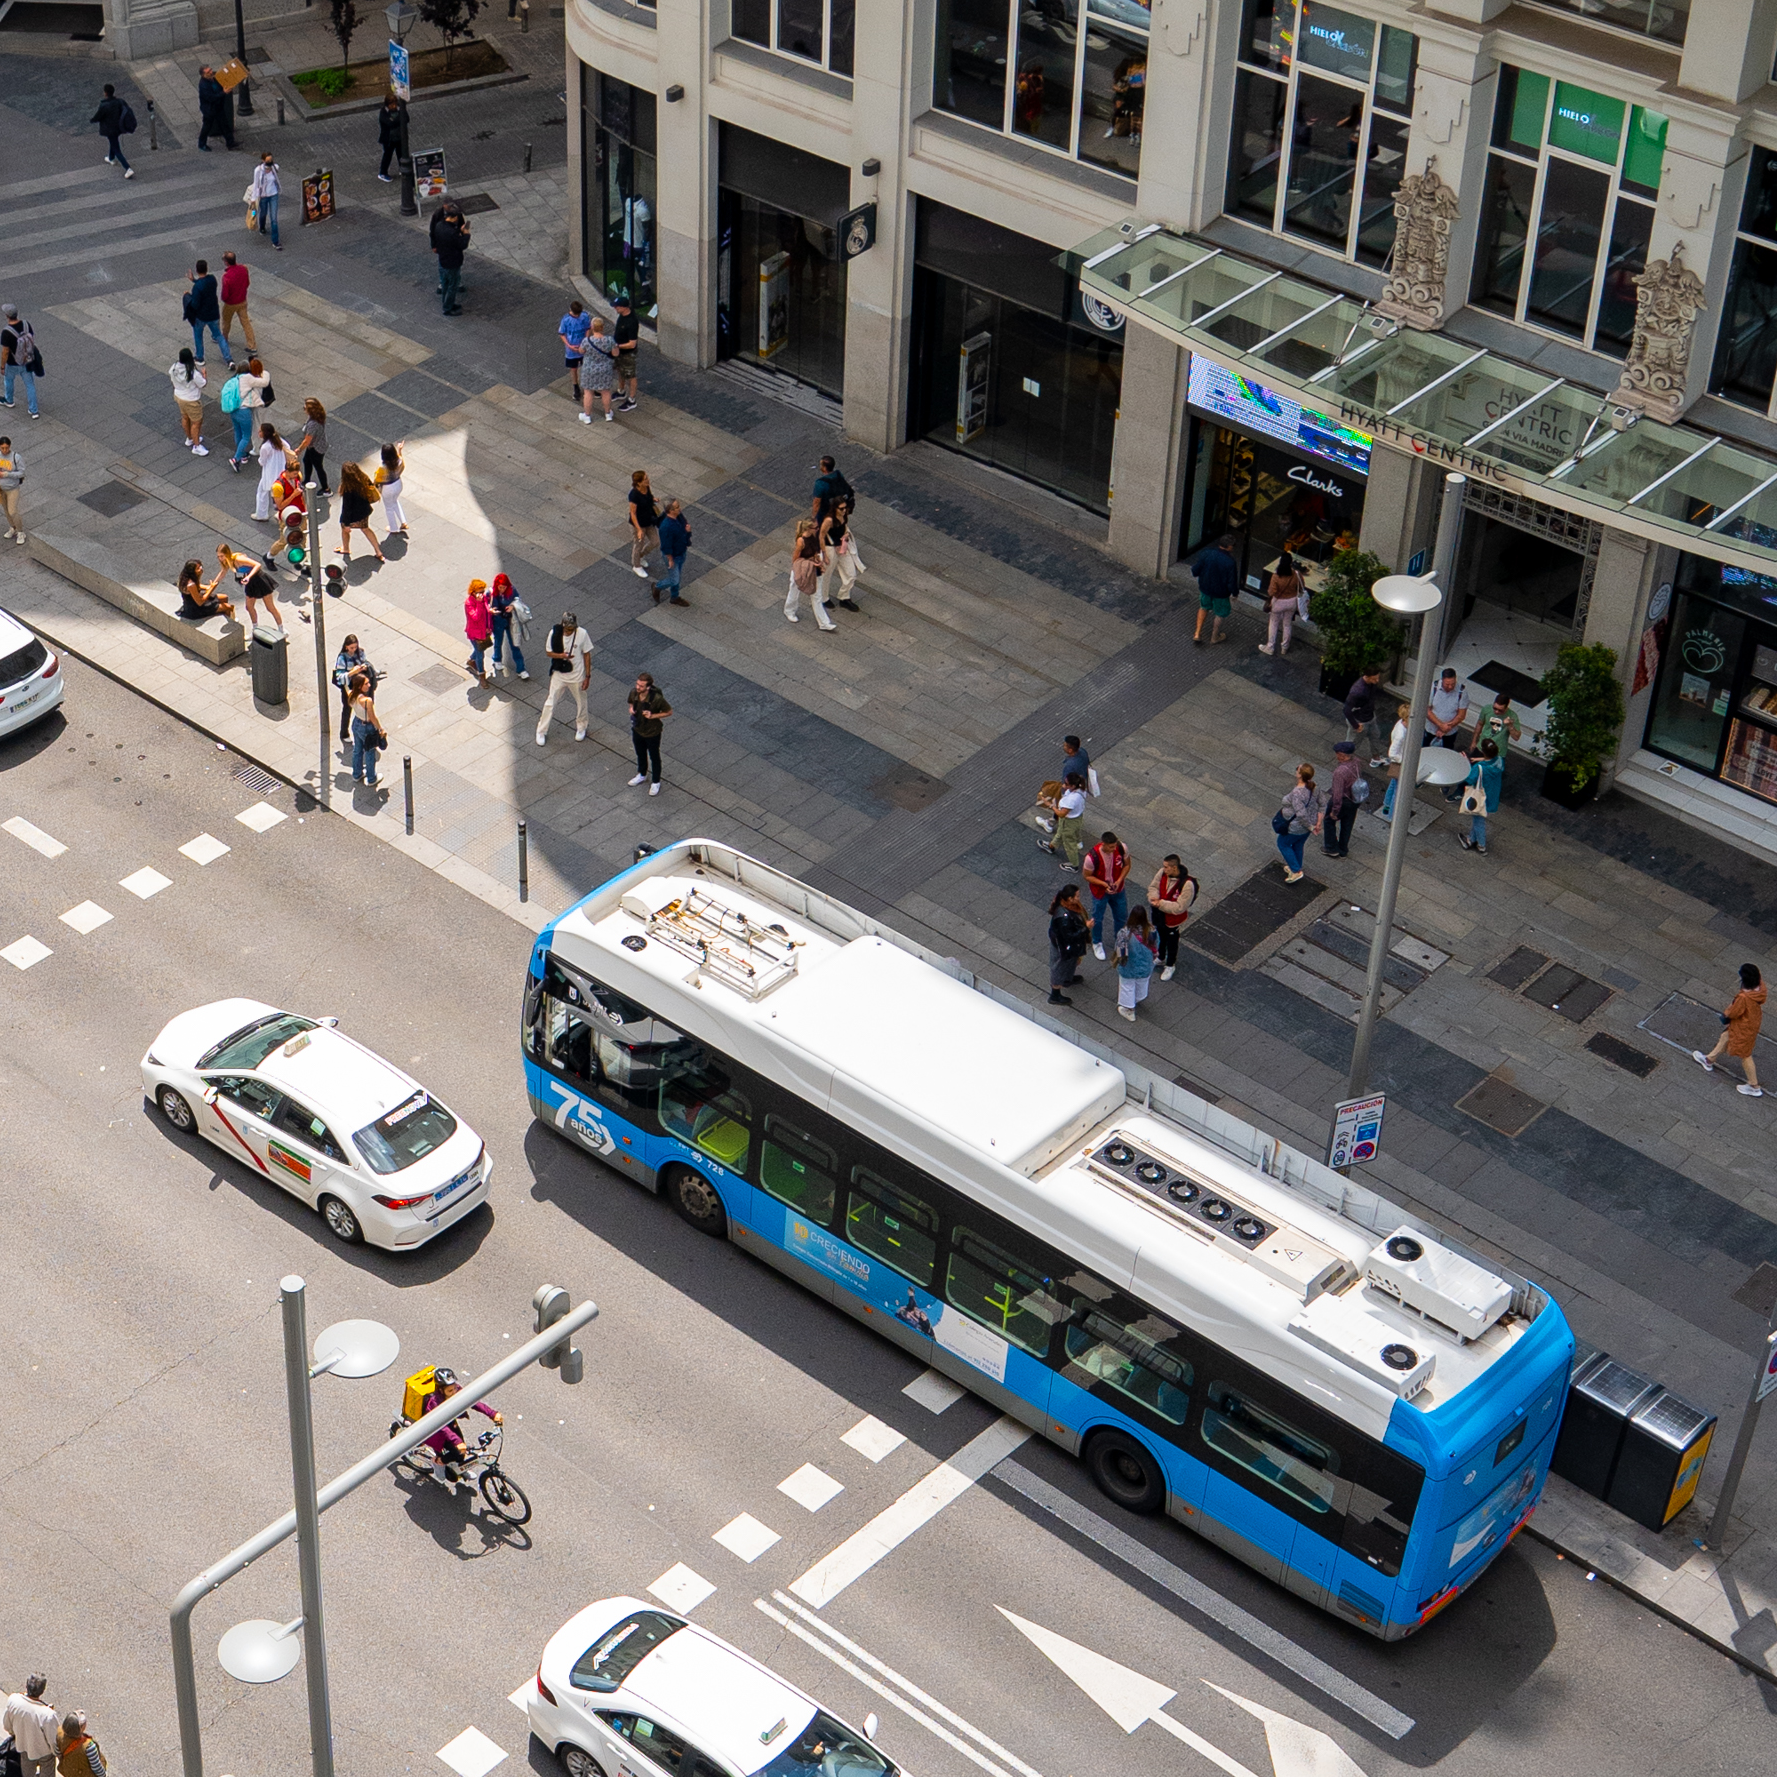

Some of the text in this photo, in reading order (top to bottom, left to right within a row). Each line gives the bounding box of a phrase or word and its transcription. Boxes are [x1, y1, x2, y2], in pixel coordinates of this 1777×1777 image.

[1309, 25, 1337, 41] HIELO
[1558, 107, 1590, 124] HIELO
[1500, 388, 1562, 418] HYTT
[1340, 401, 1509, 482] HYATT CENTRIC
[1287, 465, 1343, 497] Clarks
[1339, 1098, 1384, 1115] PRECAUCIÓN
[570, 1118, 605, 1145] años
[707, 1159, 724, 1176] 728
[809, 1232, 871, 1275] CRECIENDO
